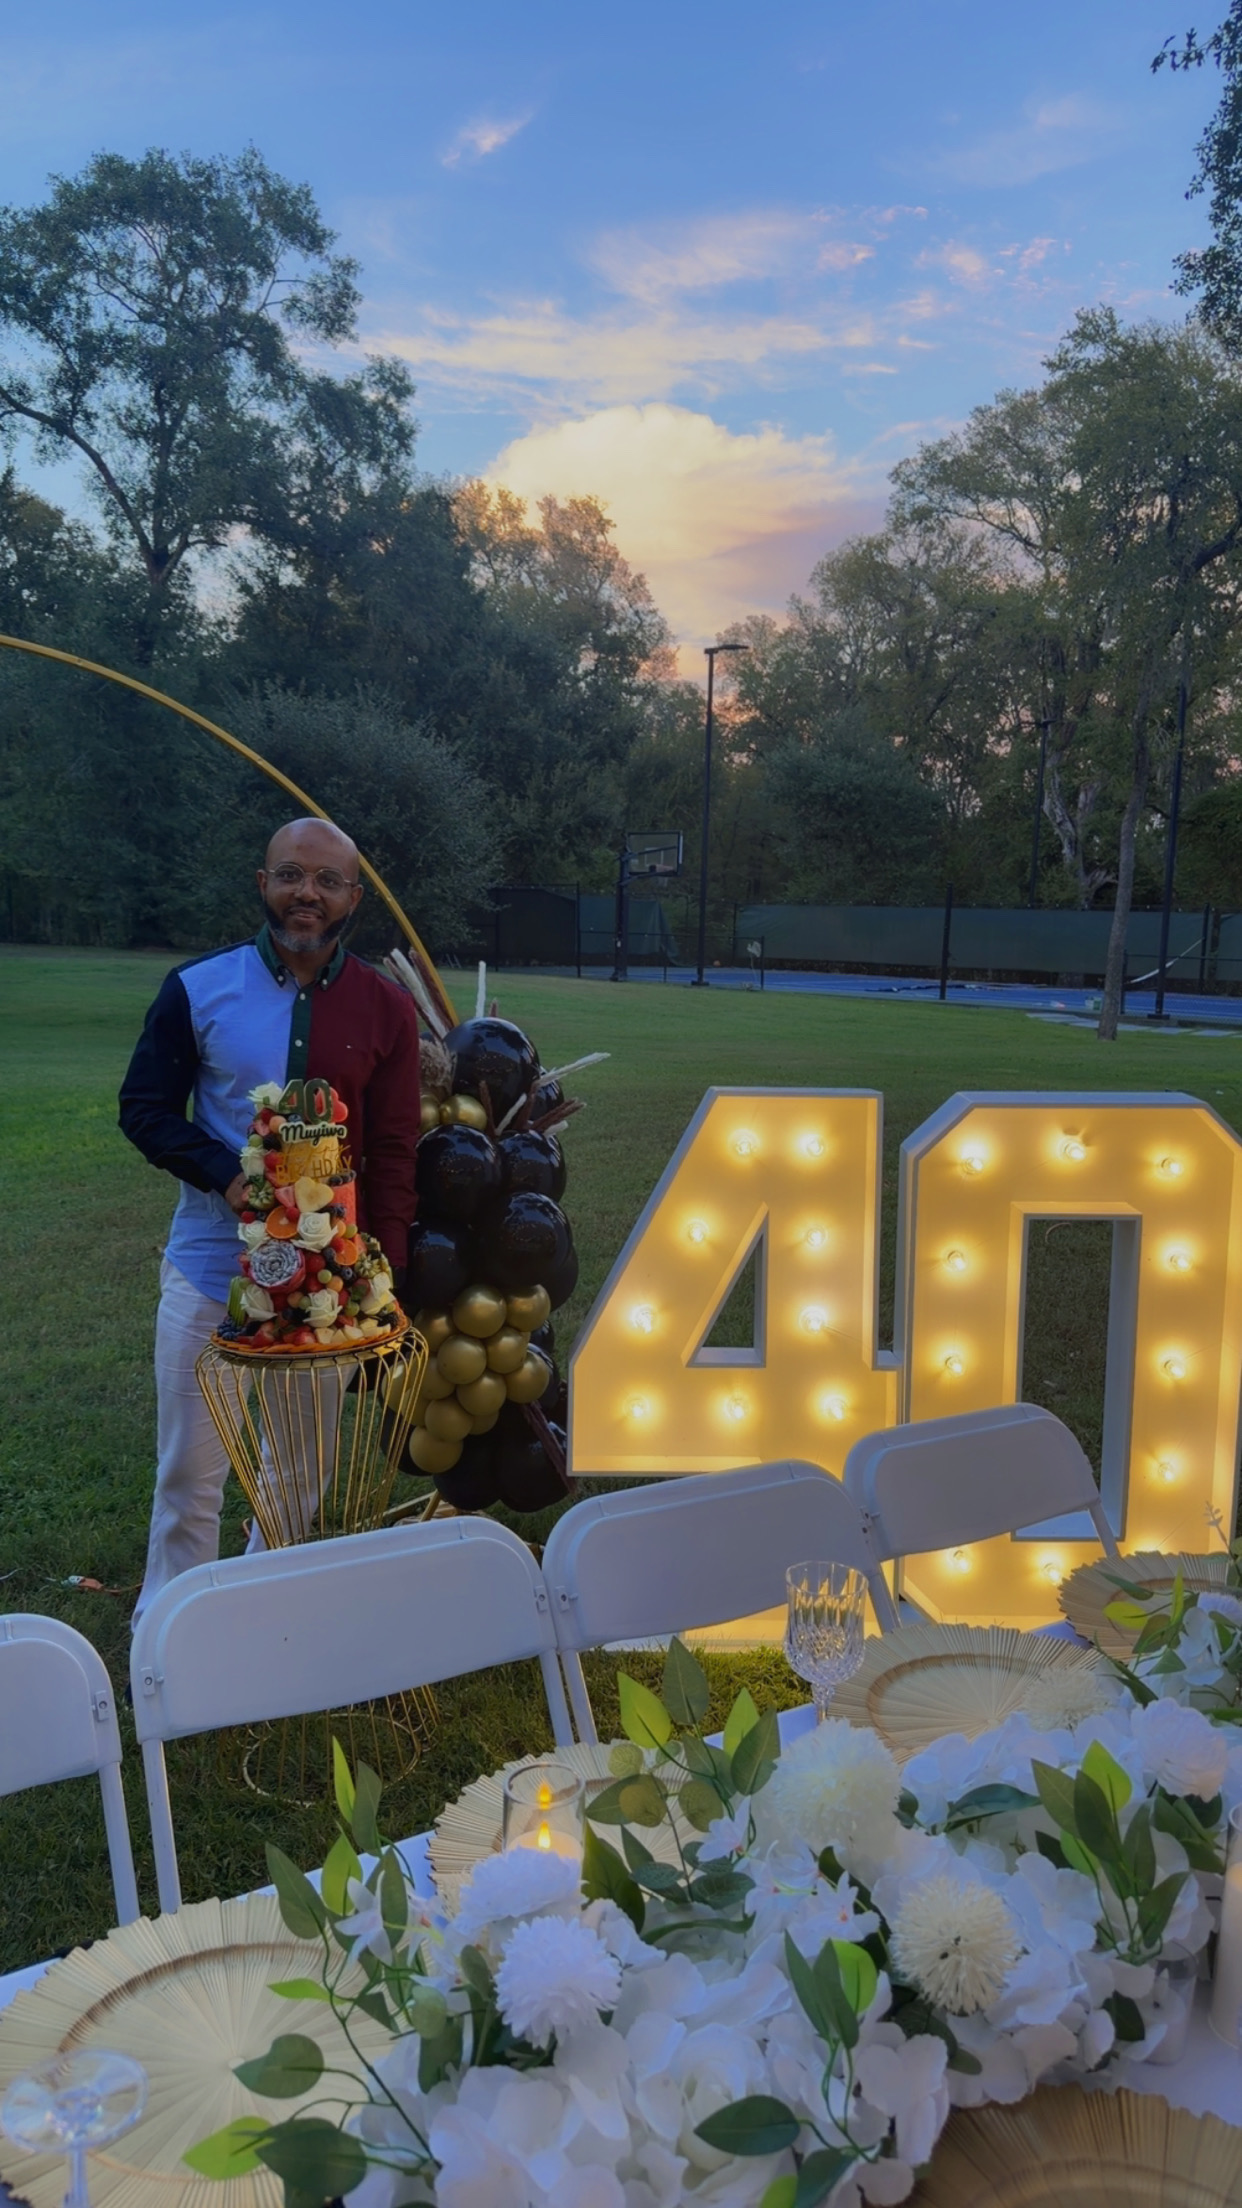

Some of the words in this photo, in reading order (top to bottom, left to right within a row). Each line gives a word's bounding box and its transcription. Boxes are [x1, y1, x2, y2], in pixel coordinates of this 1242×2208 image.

[278, 1078, 333, 1125] 40
[279, 1122, 346, 1147] Muyiwa
[275, 1154, 353, 1184] BIHDAY
[567, 1087, 1242, 1650] 40
